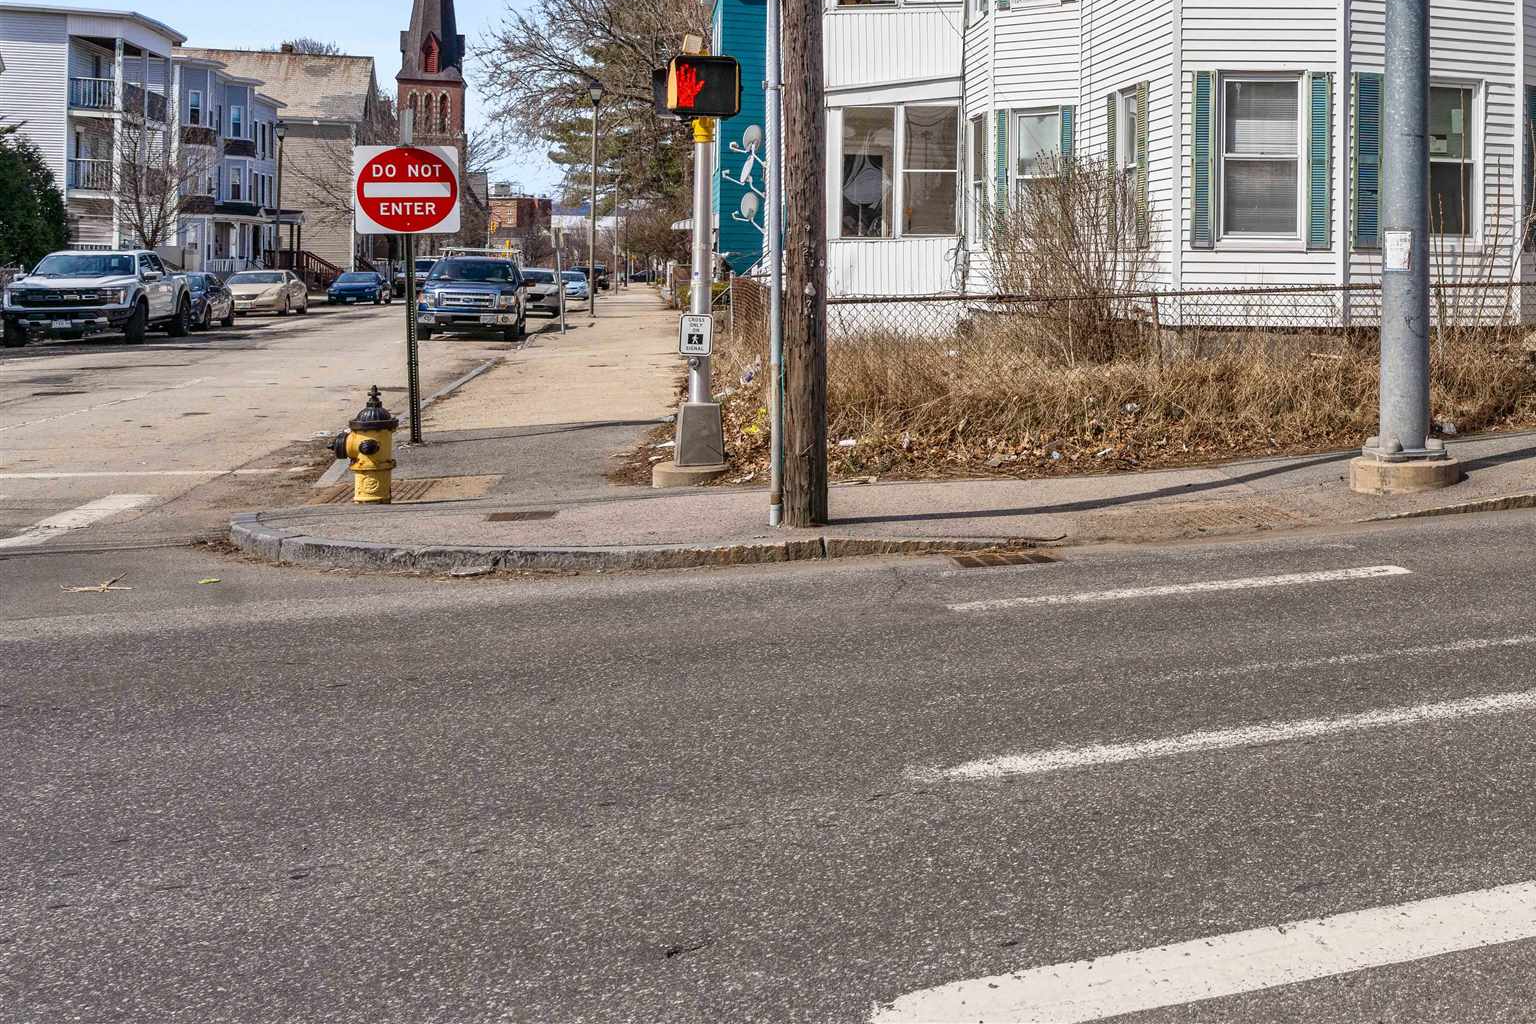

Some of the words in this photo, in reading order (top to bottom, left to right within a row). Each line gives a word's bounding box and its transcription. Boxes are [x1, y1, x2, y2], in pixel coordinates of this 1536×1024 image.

[372, 164, 397, 178] DO
[407, 164, 442, 177] NOT
[380, 202, 437, 216] ENTER
